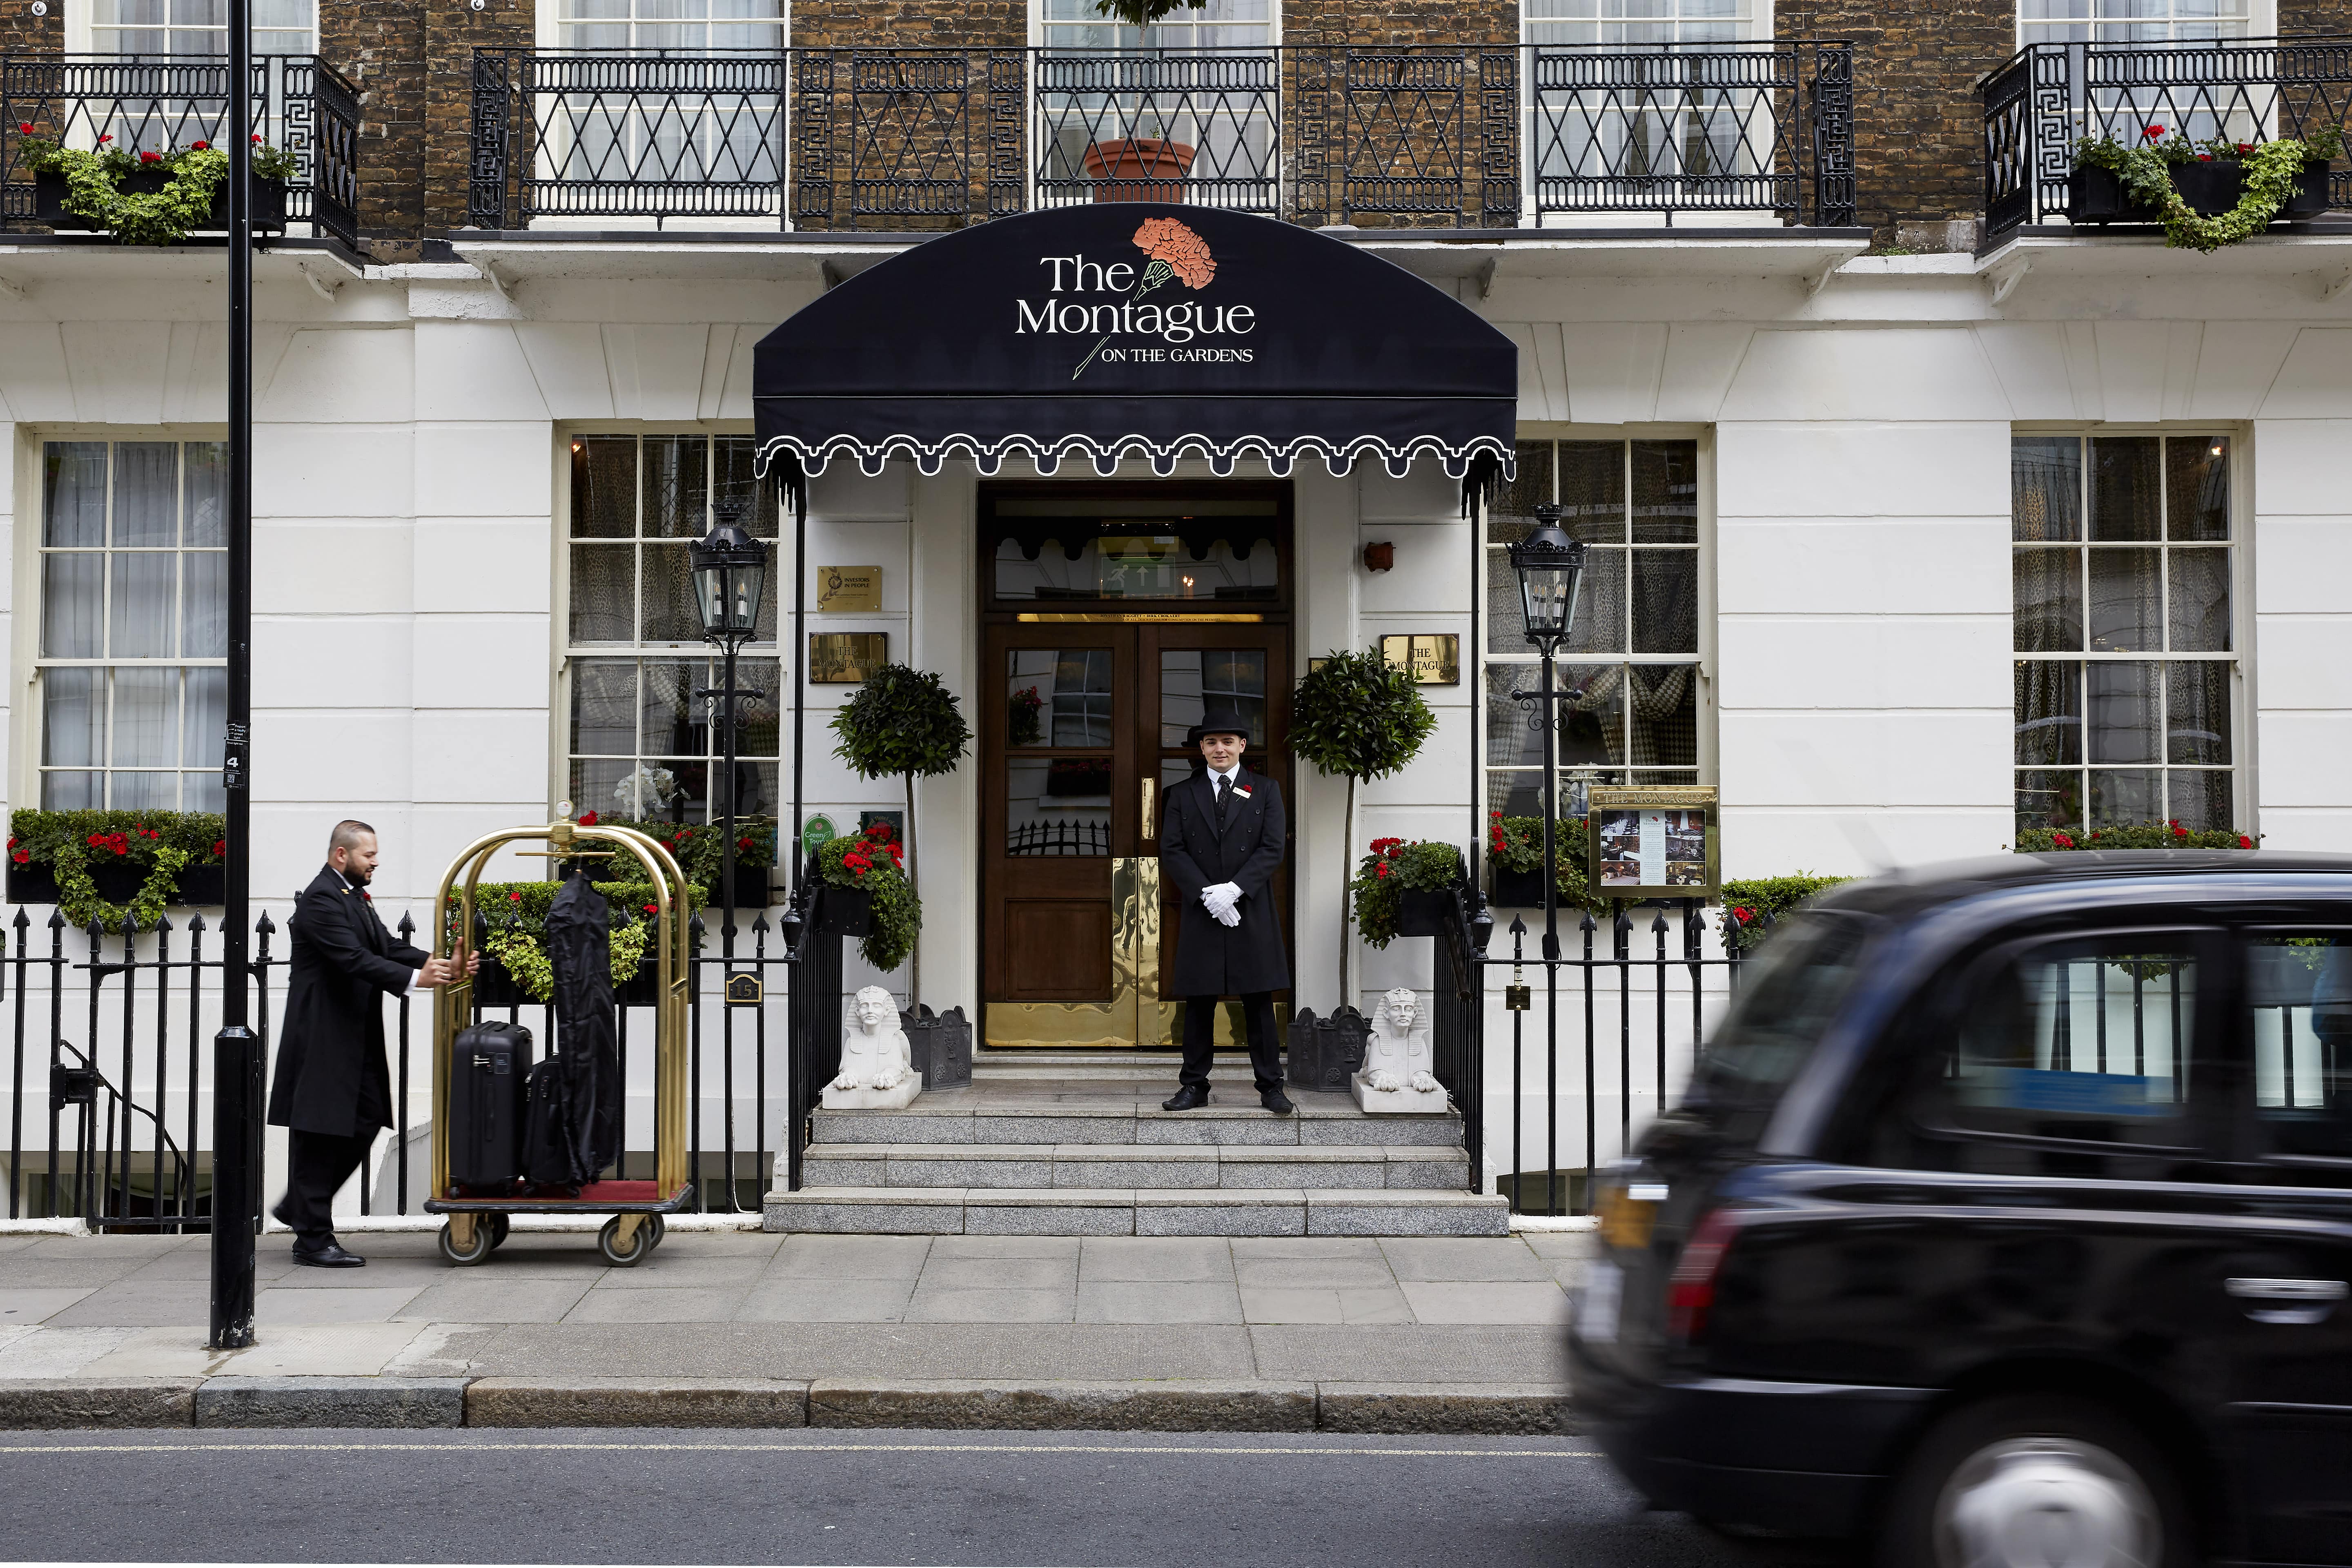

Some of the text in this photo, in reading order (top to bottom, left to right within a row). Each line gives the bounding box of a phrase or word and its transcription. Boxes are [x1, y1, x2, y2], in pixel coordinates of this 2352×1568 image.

[1040, 254, 1135, 292] The
[1015, 299, 1255, 343] Montague
[1101, 349, 1254, 363] ON THE GARDENS
[837, 646, 858, 656] THE
[1410, 648, 1431, 658] THE
[819, 659, 876, 669] MONTAGUE
[1392, 660, 1450, 670] MONTAGUE
[227, 757, 238, 767] 4
[1604, 793, 1703, 804] THE MONTAGUE
[735, 984, 752, 997] 15
